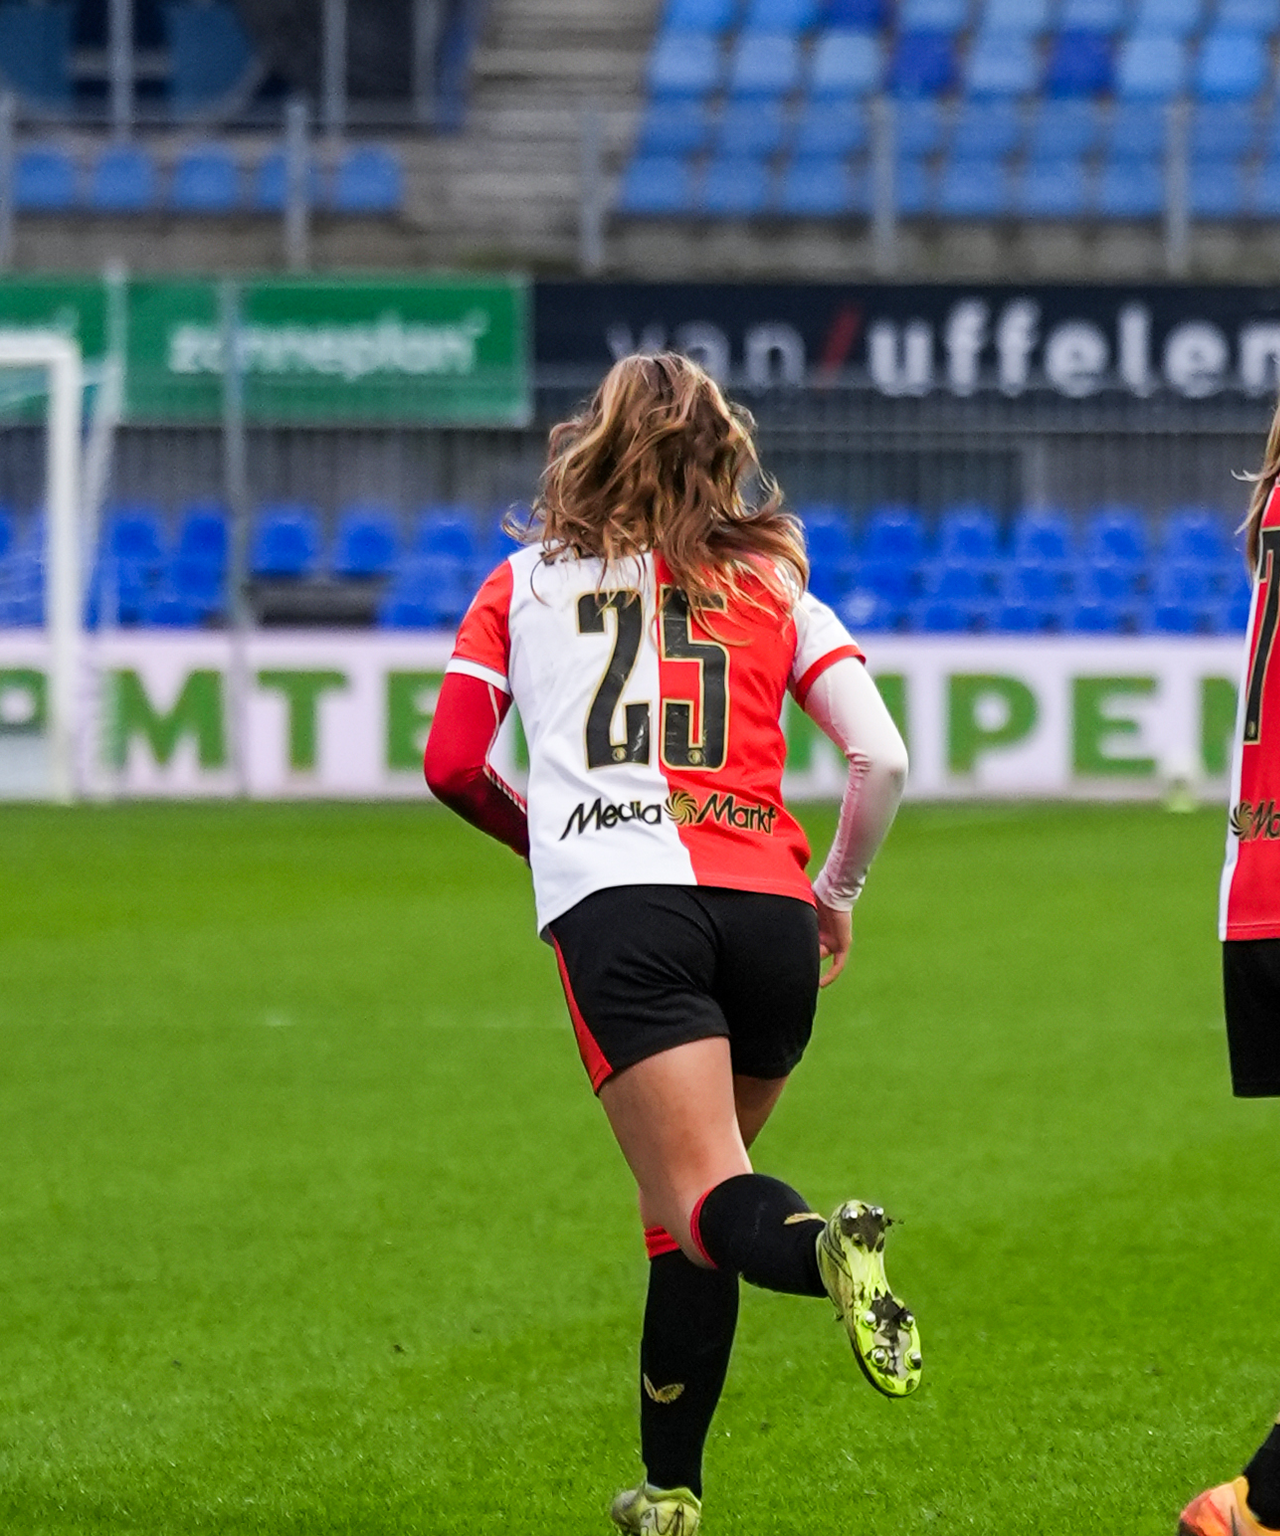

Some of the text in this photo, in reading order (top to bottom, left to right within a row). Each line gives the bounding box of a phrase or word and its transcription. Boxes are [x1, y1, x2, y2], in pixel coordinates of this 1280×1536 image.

[576, 584, 731, 773] 25
[559, 792, 777, 842] Media Markt
